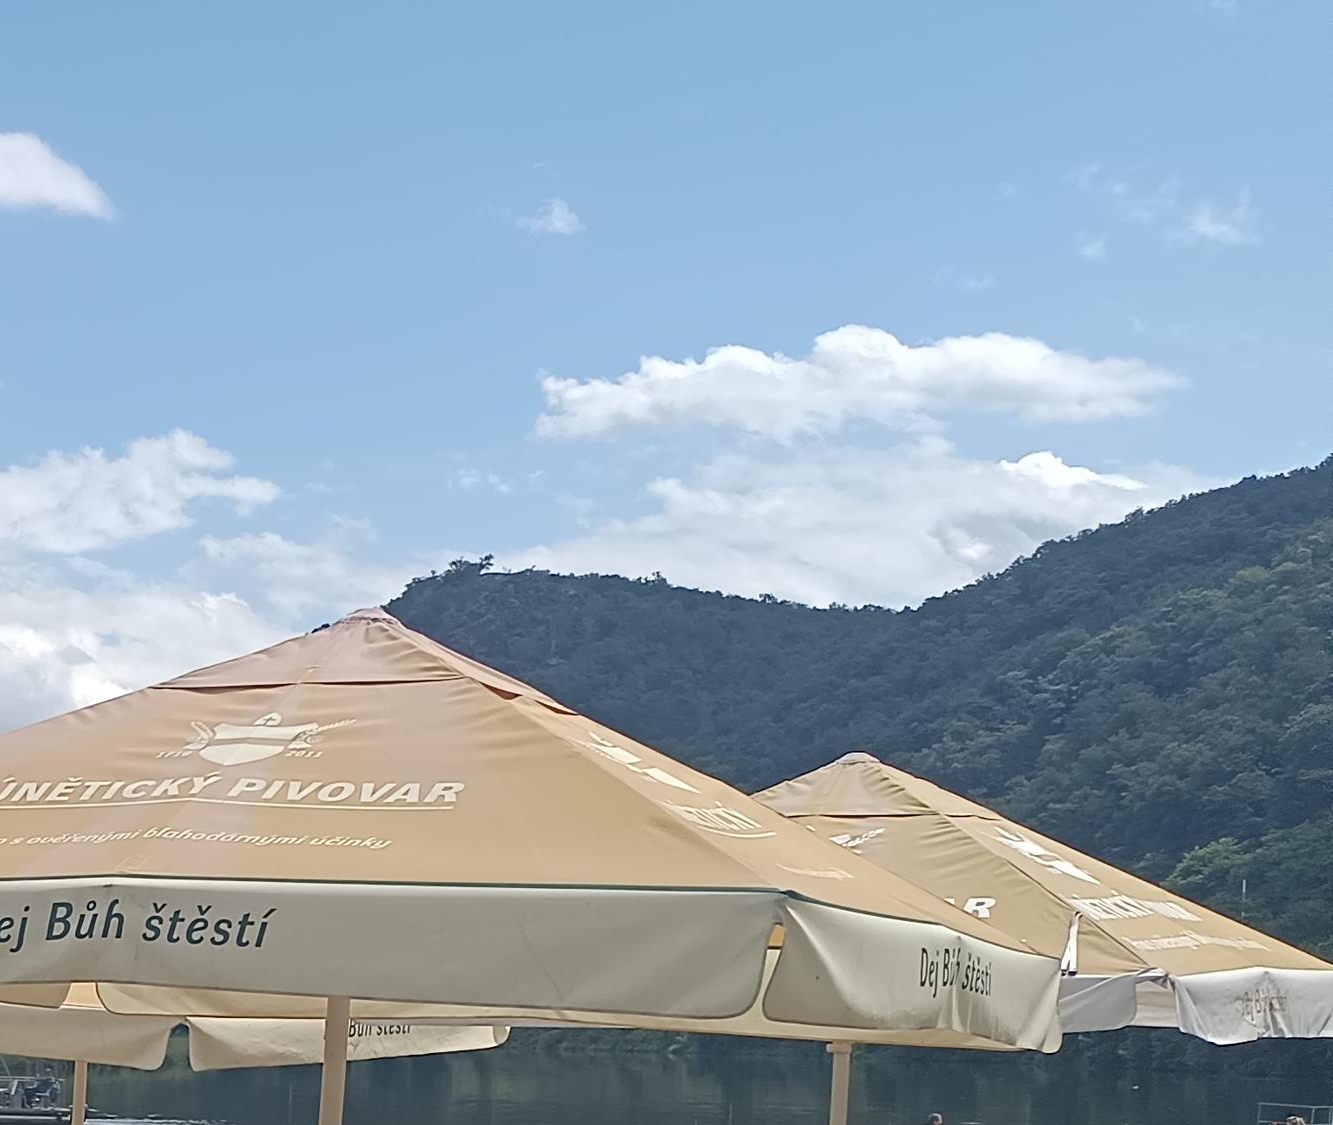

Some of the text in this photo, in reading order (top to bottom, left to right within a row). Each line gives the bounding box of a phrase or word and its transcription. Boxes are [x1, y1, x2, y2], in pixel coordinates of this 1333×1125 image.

[227, 777, 466, 803] PIVOVAR
[45, 898, 126, 943] Bůh
[141, 902, 278, 949] štěstí
[919, 947, 939, 999] Dej
